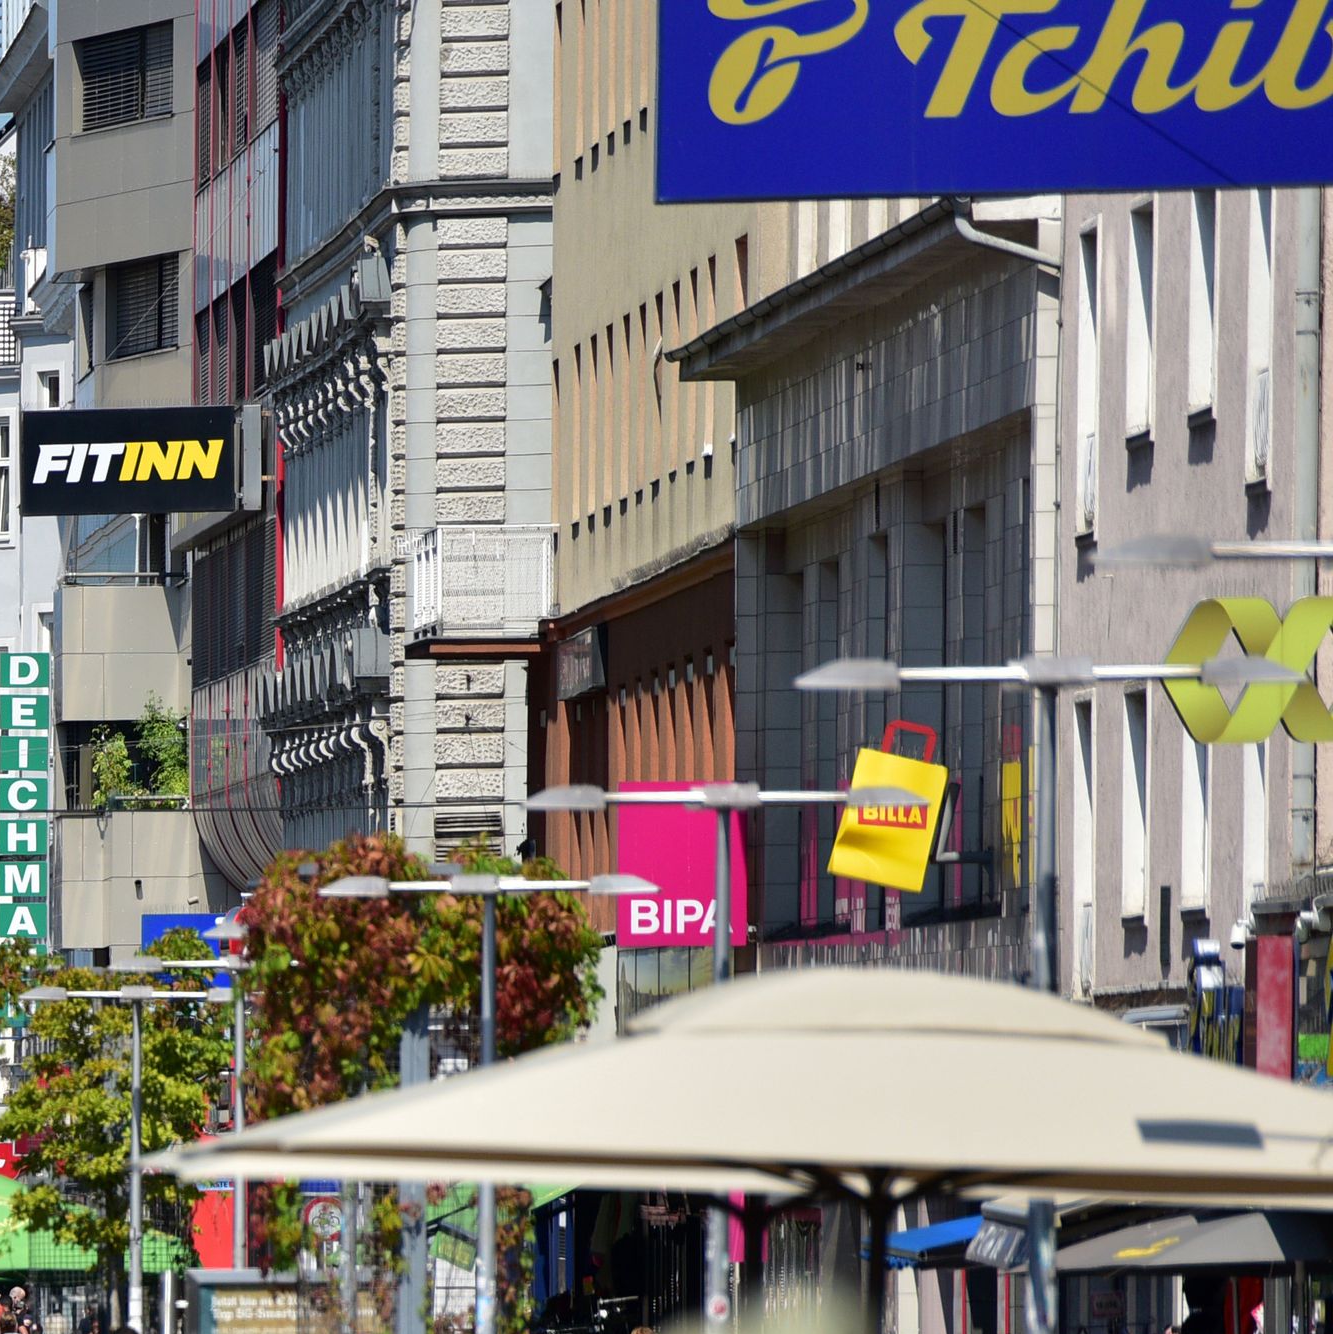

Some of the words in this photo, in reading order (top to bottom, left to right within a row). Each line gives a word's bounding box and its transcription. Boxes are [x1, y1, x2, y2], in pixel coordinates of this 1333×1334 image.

[33, 439, 224, 484] FITINN
[4, 655, 41, 958] DEICHMA
[862, 804, 922, 824] BILLA
[631, 899, 735, 935] BIPA
